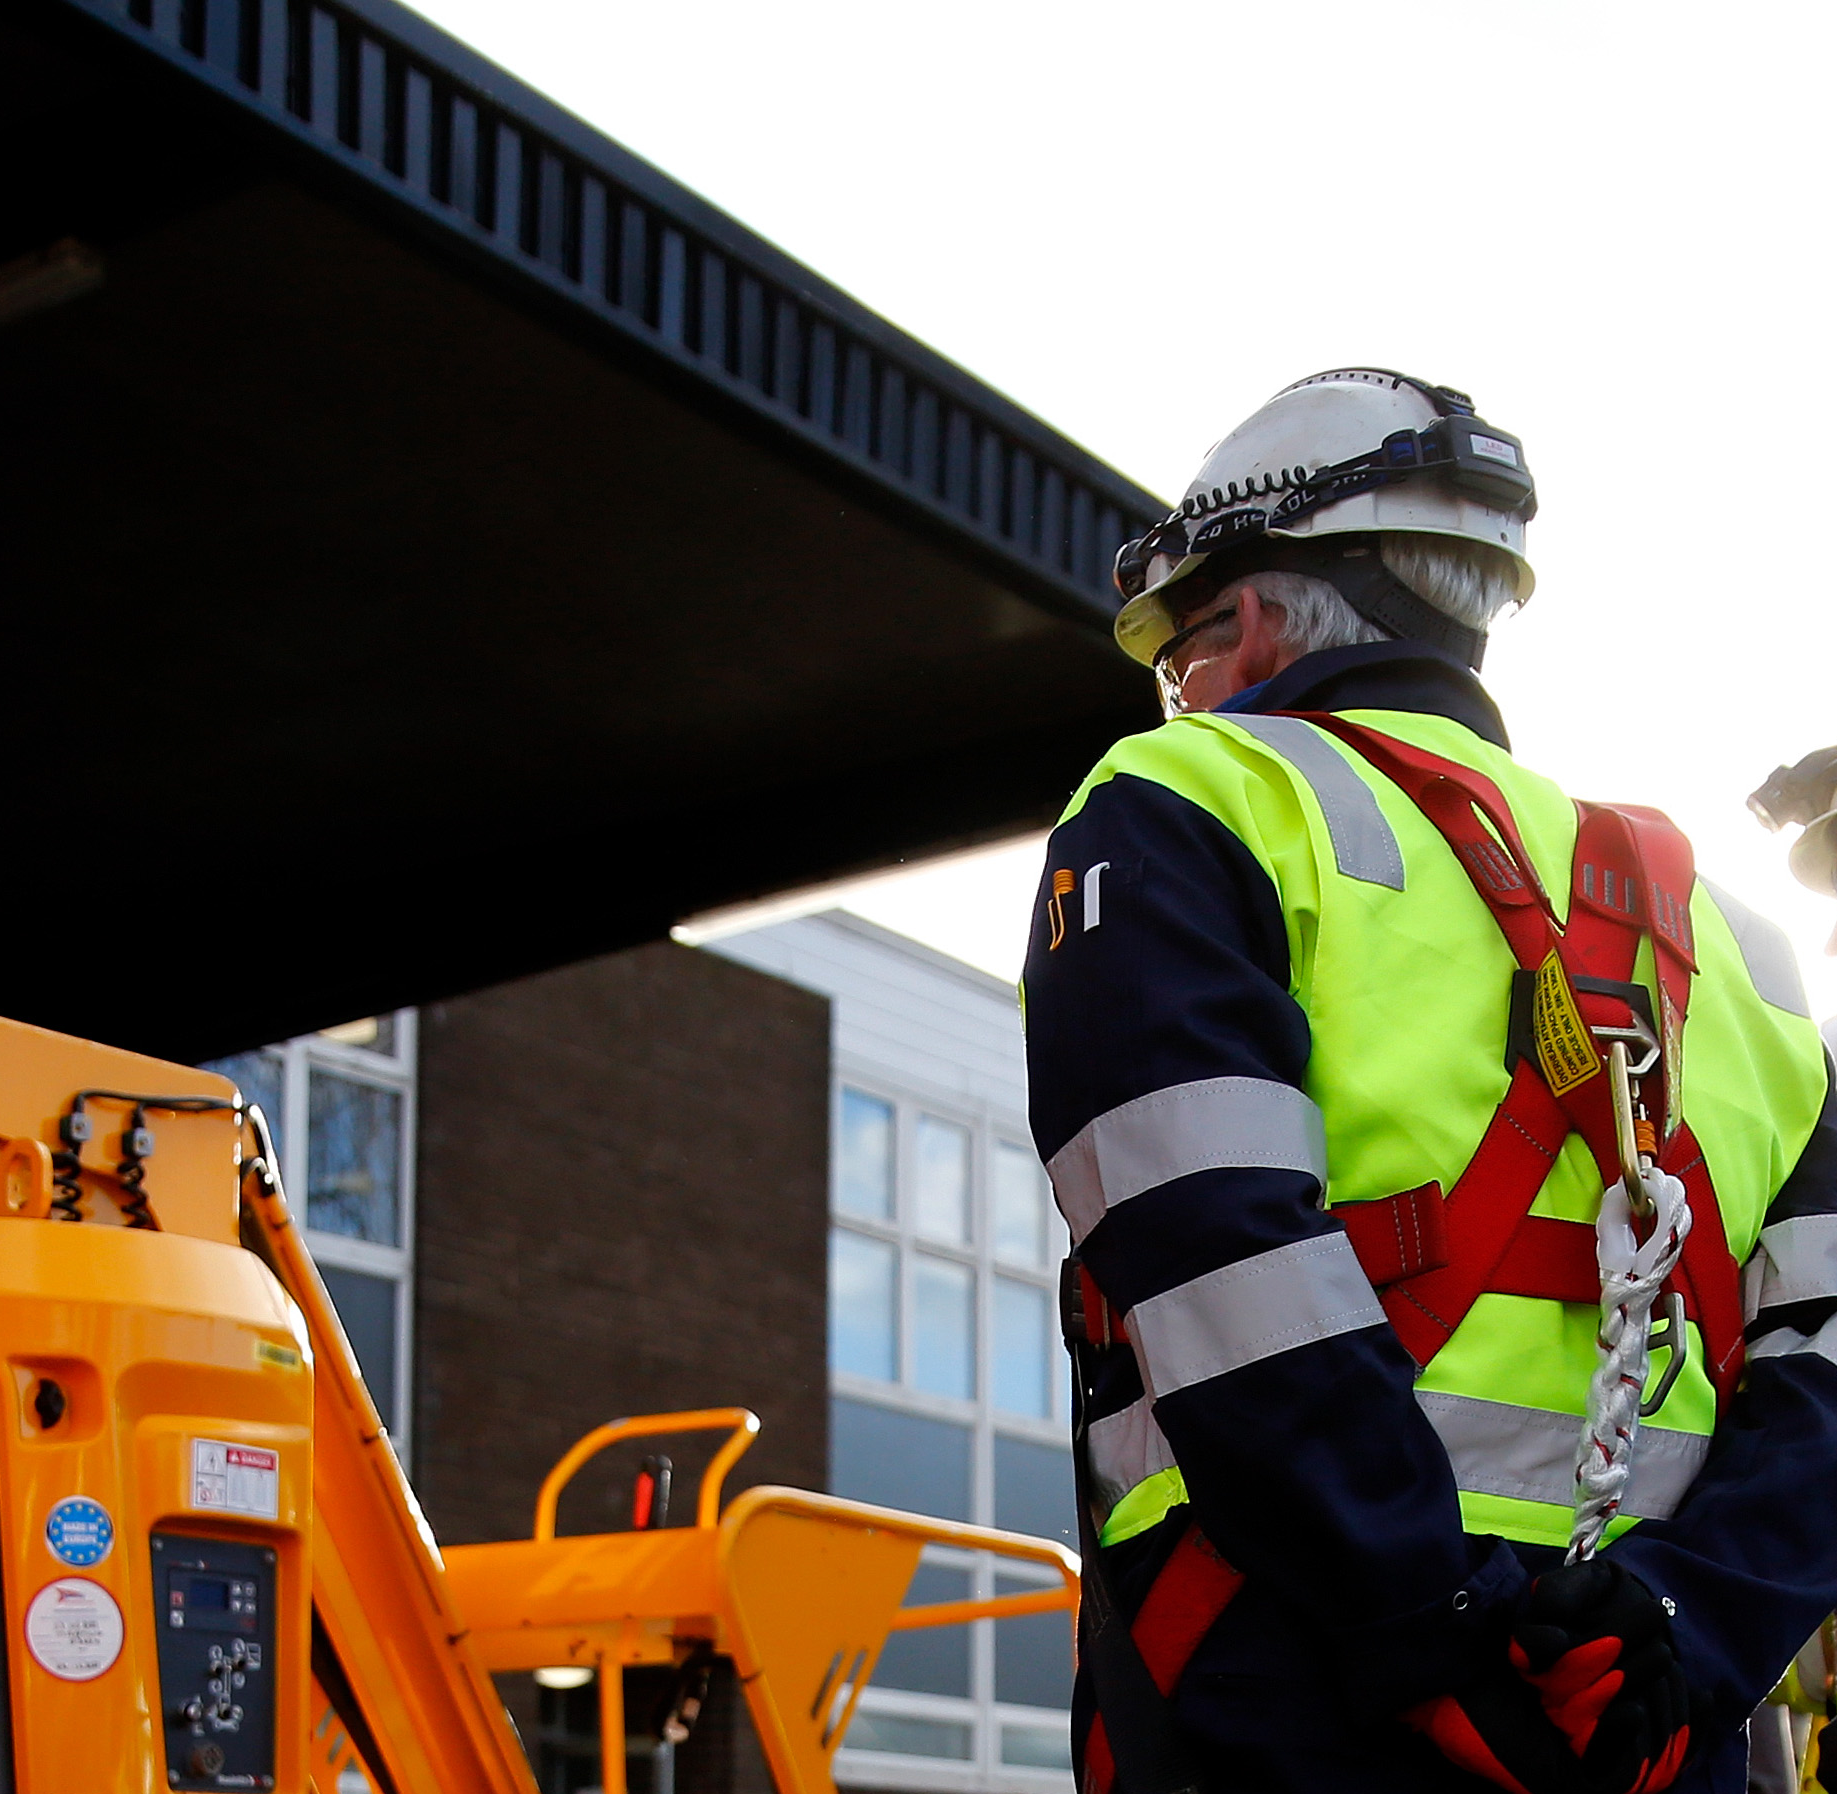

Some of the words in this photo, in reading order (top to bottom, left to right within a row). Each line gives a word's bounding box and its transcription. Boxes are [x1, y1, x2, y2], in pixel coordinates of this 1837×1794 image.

[1548, 1011, 1561, 1037] SPACE
[1562, 1014, 1574, 1034] ONLY
[1545, 1042, 1568, 1083] OVERHEAD
[1556, 1038, 1579, 1075] CONFINED
[1568, 1035, 1589, 1065] RESCUE
